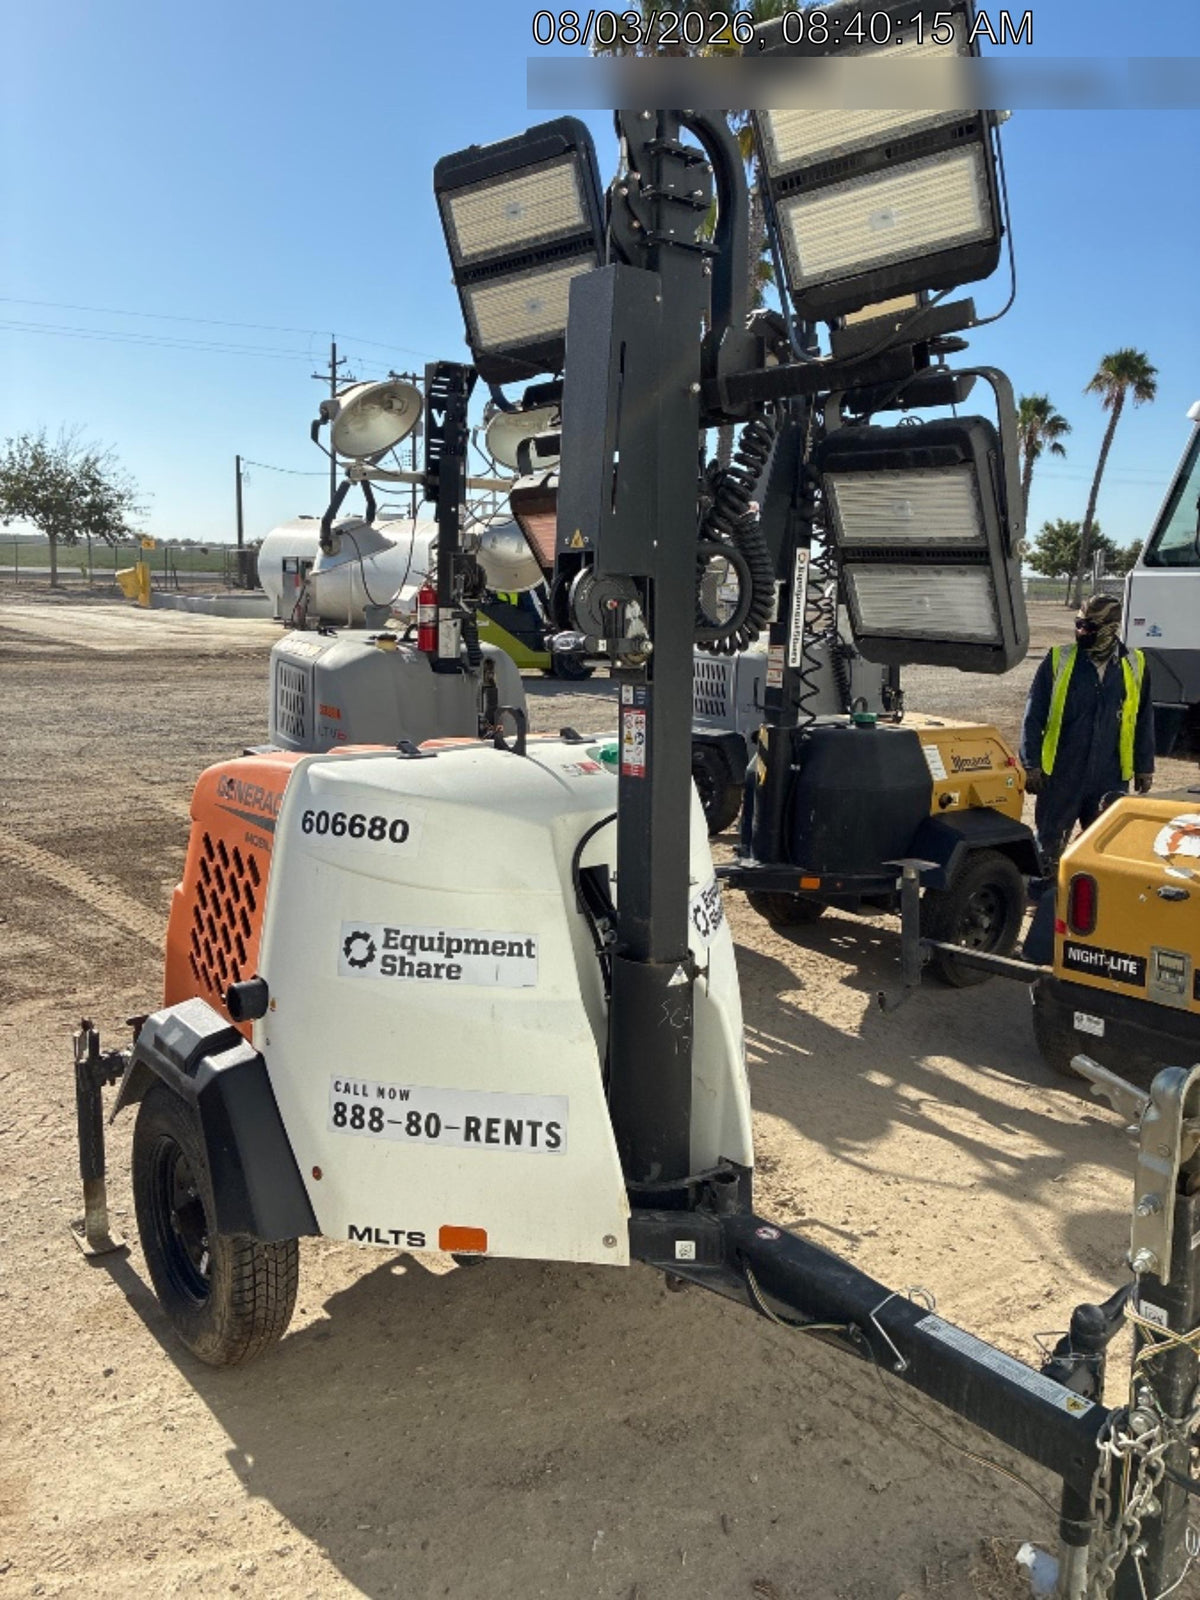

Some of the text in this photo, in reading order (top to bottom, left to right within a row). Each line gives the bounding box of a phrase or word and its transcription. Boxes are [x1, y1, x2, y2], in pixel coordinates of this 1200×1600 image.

[301, 809, 410, 844] 606680
[382, 927, 536, 959] Equipment
[380, 954, 463, 981] Share
[1067, 946, 1138, 976] NIGHT-LITE
[333, 1080, 411, 1101] CALL NOW
[332, 1101, 562, 1150] 888-80-RENTS
[347, 1224, 427, 1248] MLTS
